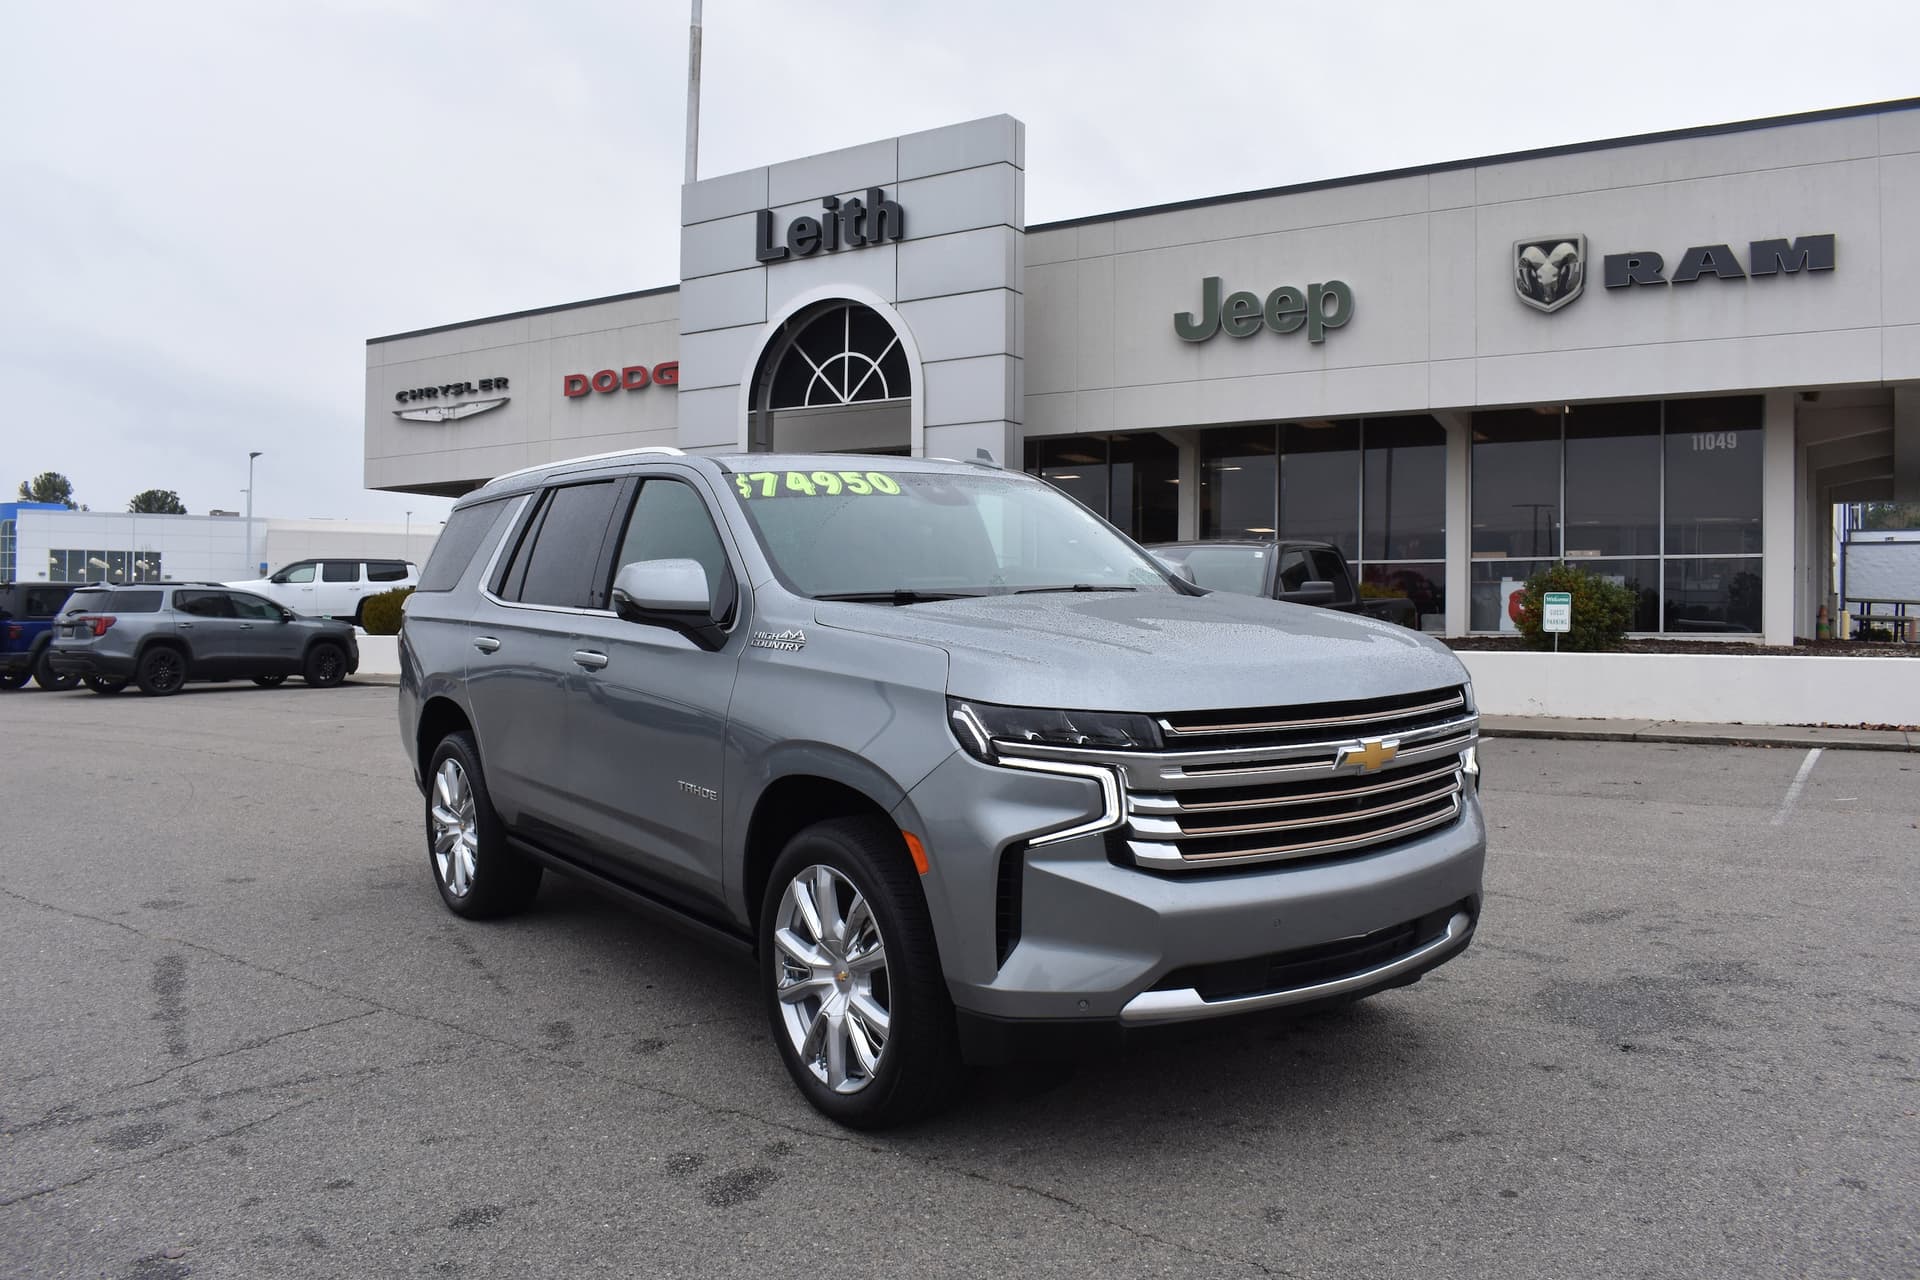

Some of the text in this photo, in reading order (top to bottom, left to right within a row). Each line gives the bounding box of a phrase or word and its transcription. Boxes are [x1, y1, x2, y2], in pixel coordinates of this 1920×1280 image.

[756, 187, 903, 262] Leith
[1604, 233, 1835, 289] RAM
[1174, 276, 1354, 344] Jeep
[396, 377, 509, 402] CHRYSLER
[1692, 432, 1737, 450] 11049
[736, 471, 901, 498] $74950
[751, 639, 805, 651] COUNTRY
[753, 631, 780, 640] HIGH
[677, 780, 718, 800] TAHOE
